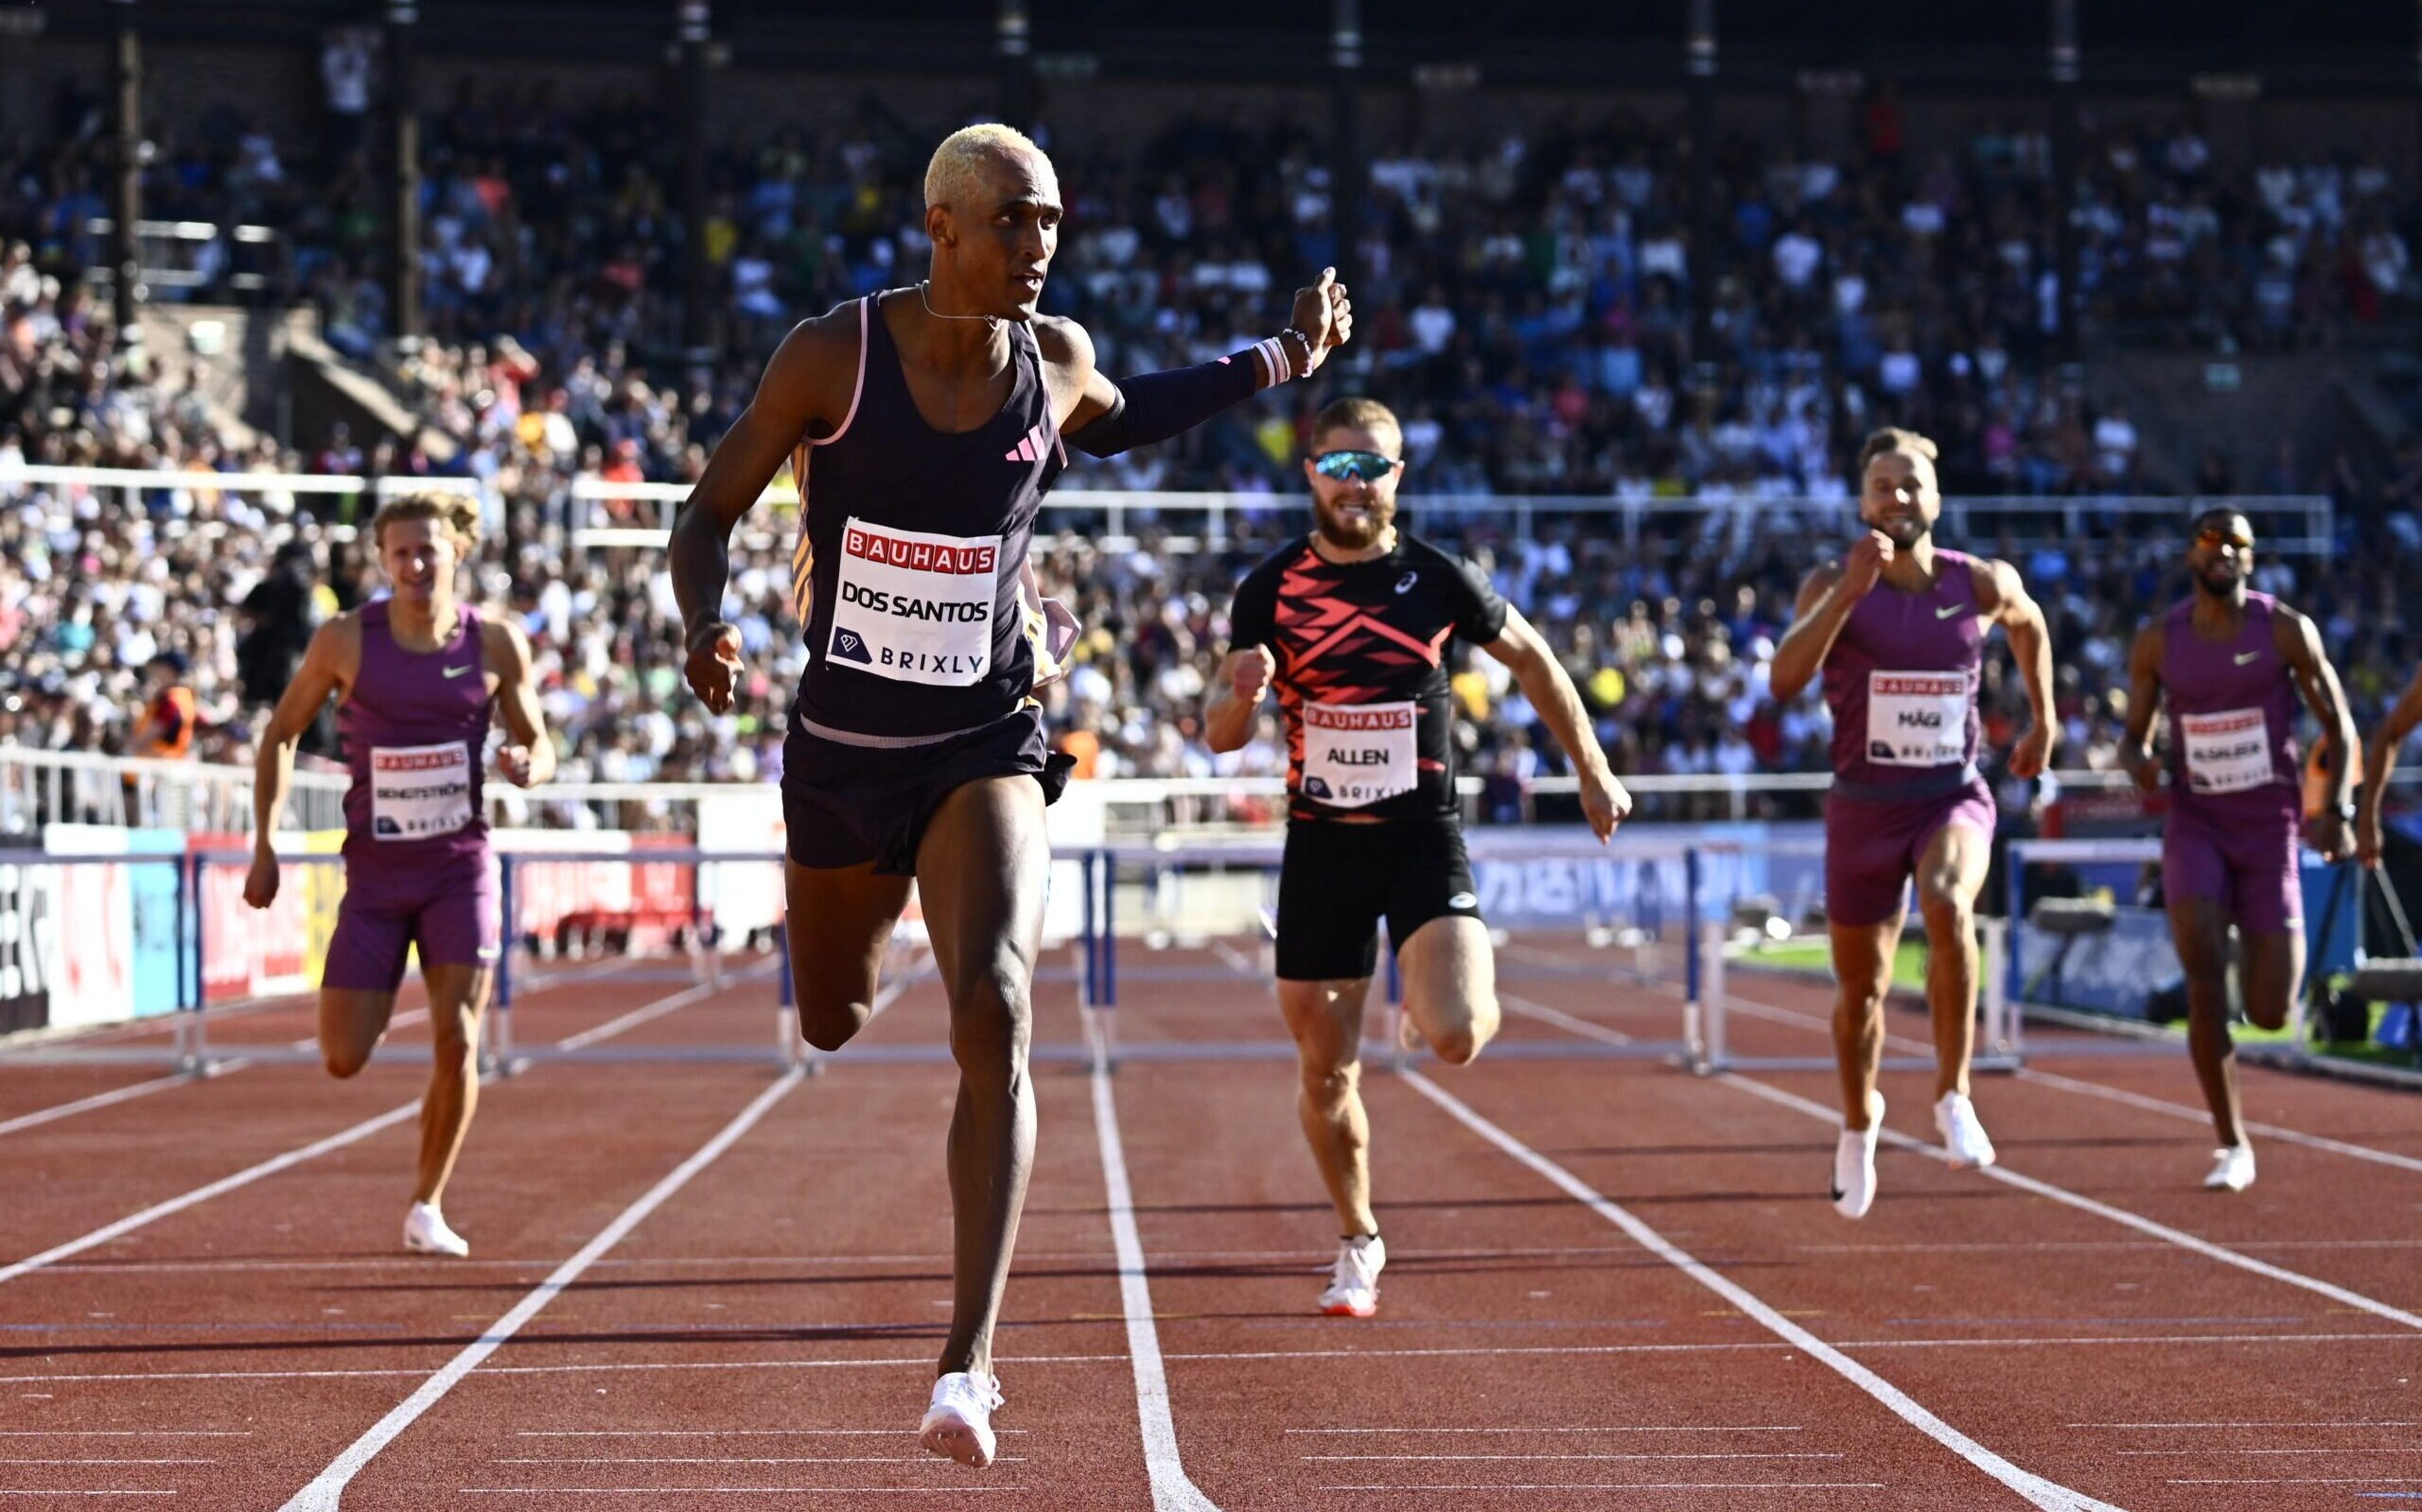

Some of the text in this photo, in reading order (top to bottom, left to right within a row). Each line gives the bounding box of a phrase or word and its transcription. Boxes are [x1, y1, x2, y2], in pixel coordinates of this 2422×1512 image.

[848, 533, 992, 571] BAUHAUS
[842, 580, 989, 623] DOS SANTOS
[880, 646, 984, 674] BRIXLY
[1307, 708, 1410, 728] BAUHAUS
[1327, 747, 1389, 765] ALLEN
